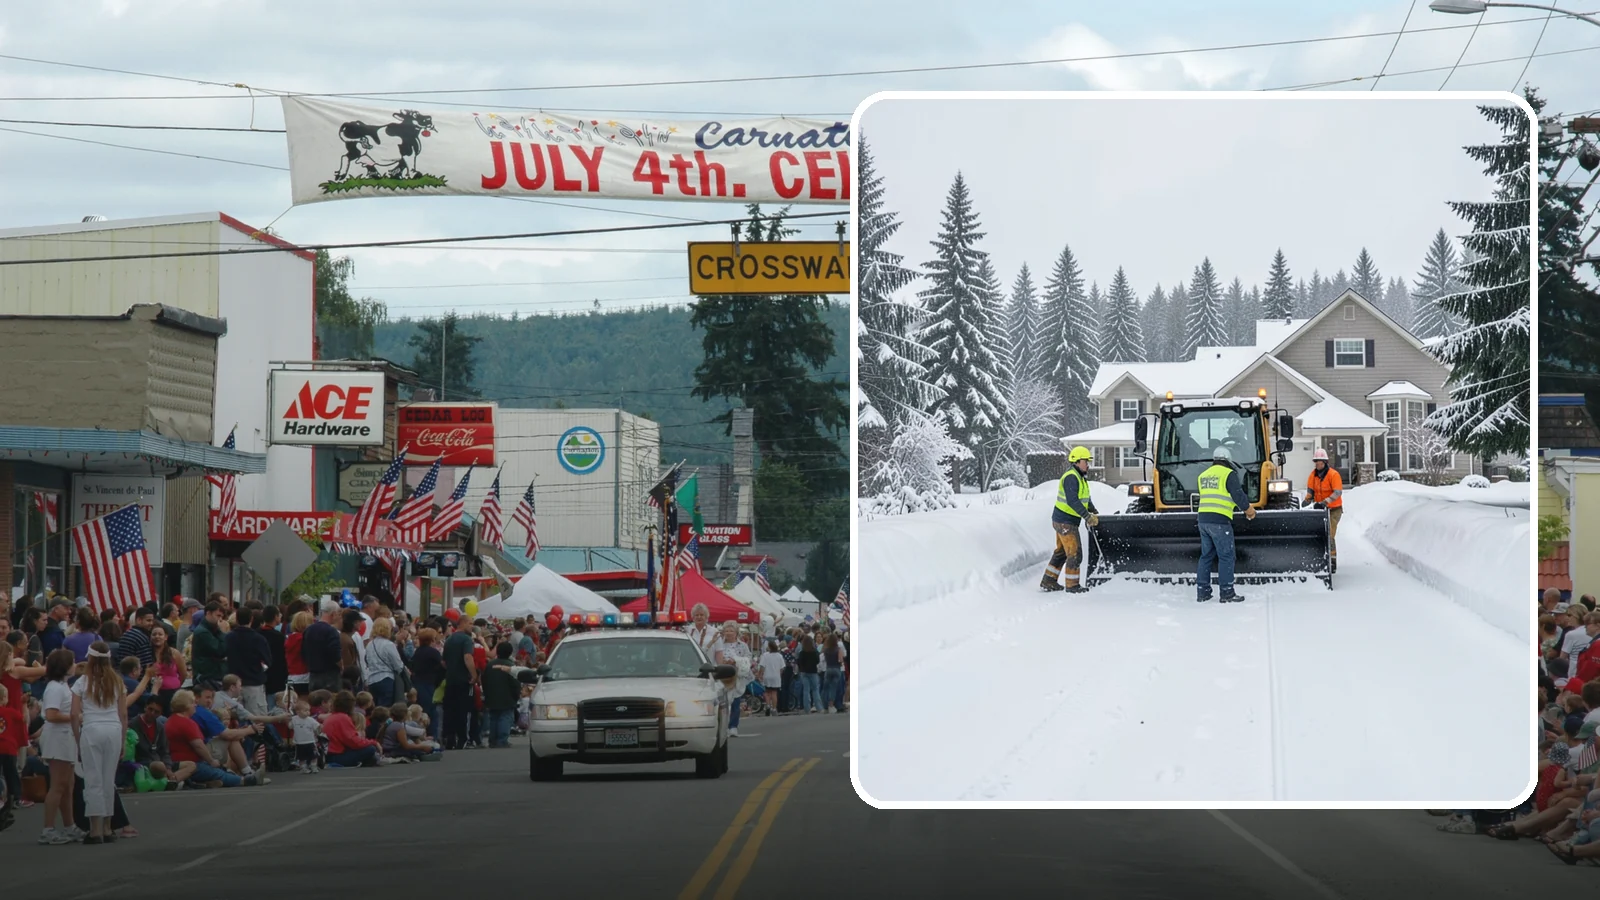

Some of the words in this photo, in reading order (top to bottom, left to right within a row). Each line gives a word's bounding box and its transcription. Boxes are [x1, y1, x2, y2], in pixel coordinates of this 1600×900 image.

[481, 141, 605, 192] JULY
[632, 150, 747, 198] 4th.
[696, 254, 850, 281] CROSSWA
[282, 380, 373, 419] ACE
[406, 409, 452, 422] CEDAR
[283, 421, 371, 436] Hardware
[83, 485, 93, 494] St.
[96, 485, 124, 495] Vincent
[126, 485, 135, 495] de
[138, 486, 155, 495] Paul
[688, 526, 741, 535] CRNATION
[699, 535, 730, 543] GLASS
